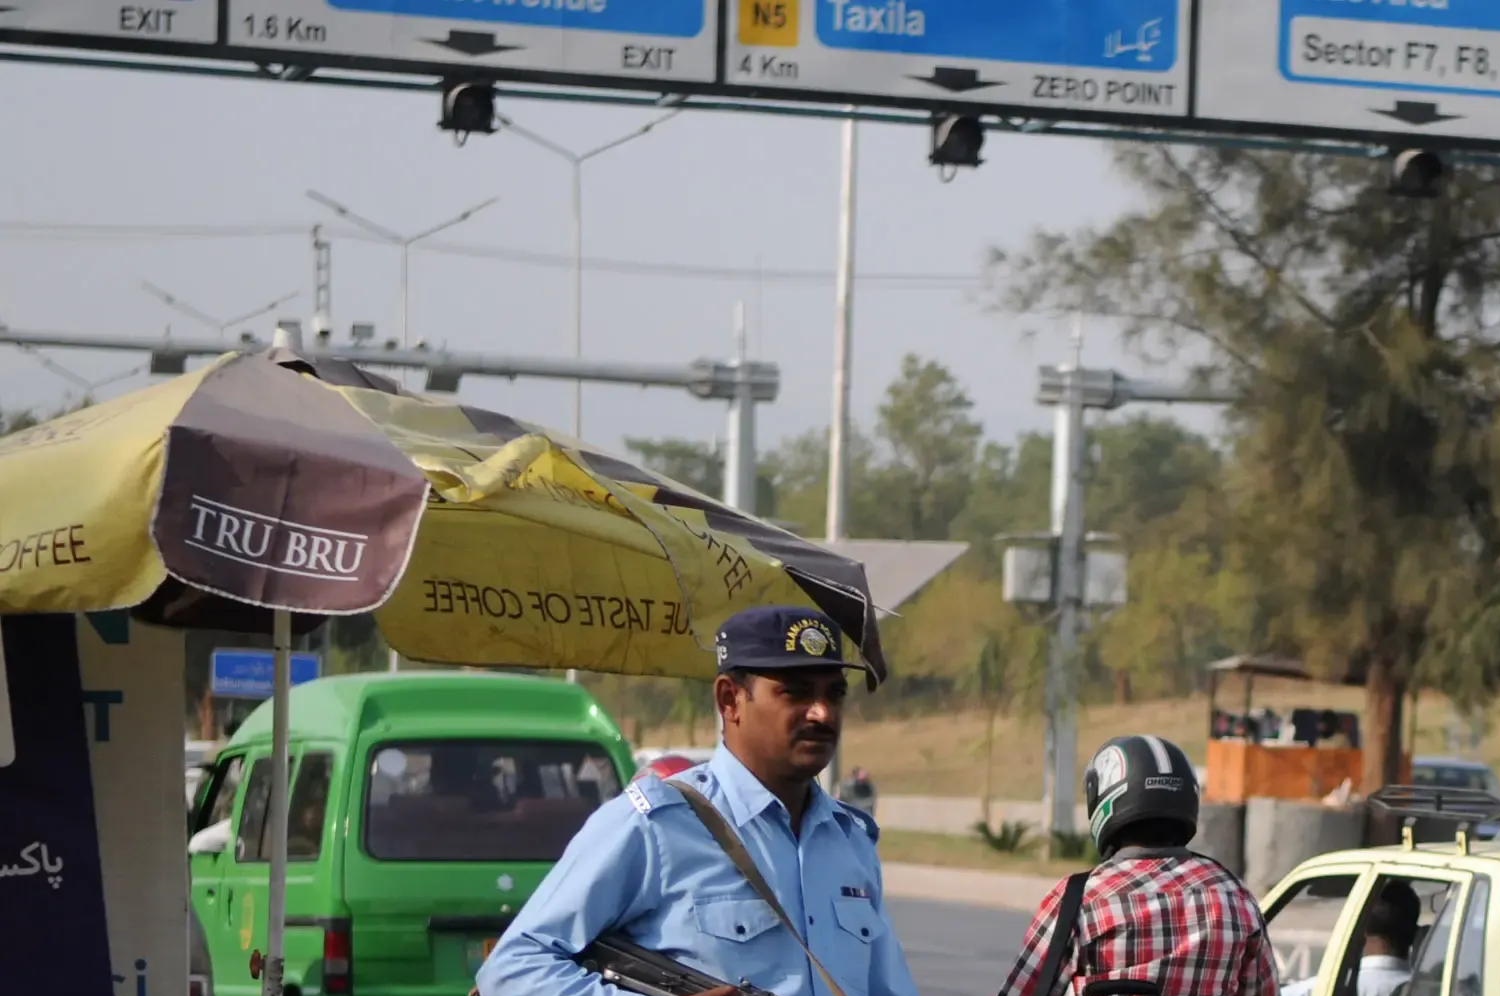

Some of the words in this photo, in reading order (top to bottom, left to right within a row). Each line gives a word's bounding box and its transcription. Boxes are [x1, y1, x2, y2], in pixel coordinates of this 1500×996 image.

[118, 6, 178, 35] EXIT
[244, 14, 280, 40] 1.6
[286, 17, 328, 43] Km
[752, 2, 787, 30] N5
[826, 0, 926, 37] Taxila
[621, 45, 677, 71] EXIT
[738, 54, 753, 76] 4
[760, 55, 799, 80] Km
[1301, 33, 1396, 68] Sector
[1403, 41, 1447, 78] F7,
[1453, 45, 1498, 82] F8,
[1032, 75, 1099, 101] ZERO
[1105, 80, 1178, 106] POINT
[0, 524, 91, 573] OFFEE
[190, 503, 275, 558] TRU
[282, 531, 367, 574] BRU
